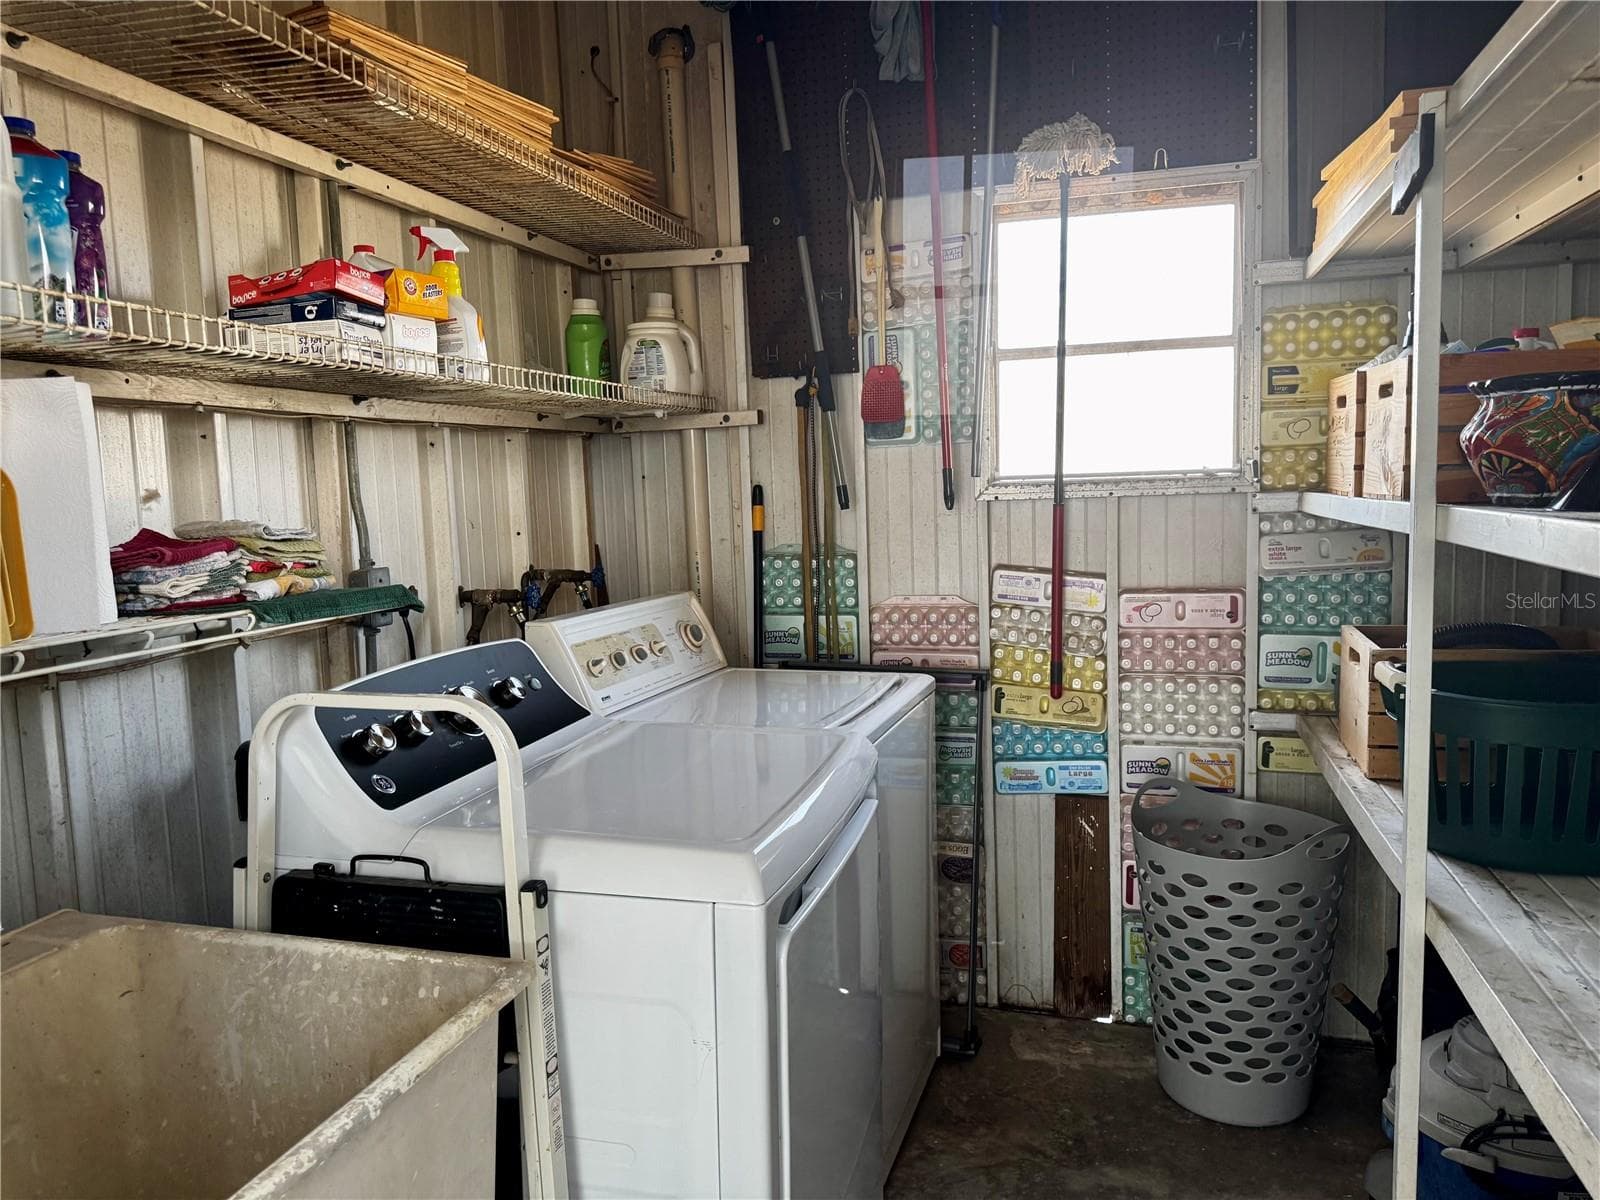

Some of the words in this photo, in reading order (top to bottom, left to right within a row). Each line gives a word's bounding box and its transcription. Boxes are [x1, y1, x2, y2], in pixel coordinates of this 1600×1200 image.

[350, 266, 371, 280] bounce
[232, 290, 257, 305] bounce
[403, 325, 431, 339] bounce
[890, 335, 898, 364] SUNNY
[765, 637, 800, 645] MEADOW
[1266, 652, 1298, 660] SUNNY
[1266, 658, 1310, 668] MEADOW
[1127, 760, 1157, 768] SUNNY
[1127, 767, 1169, 776] MEADOW
